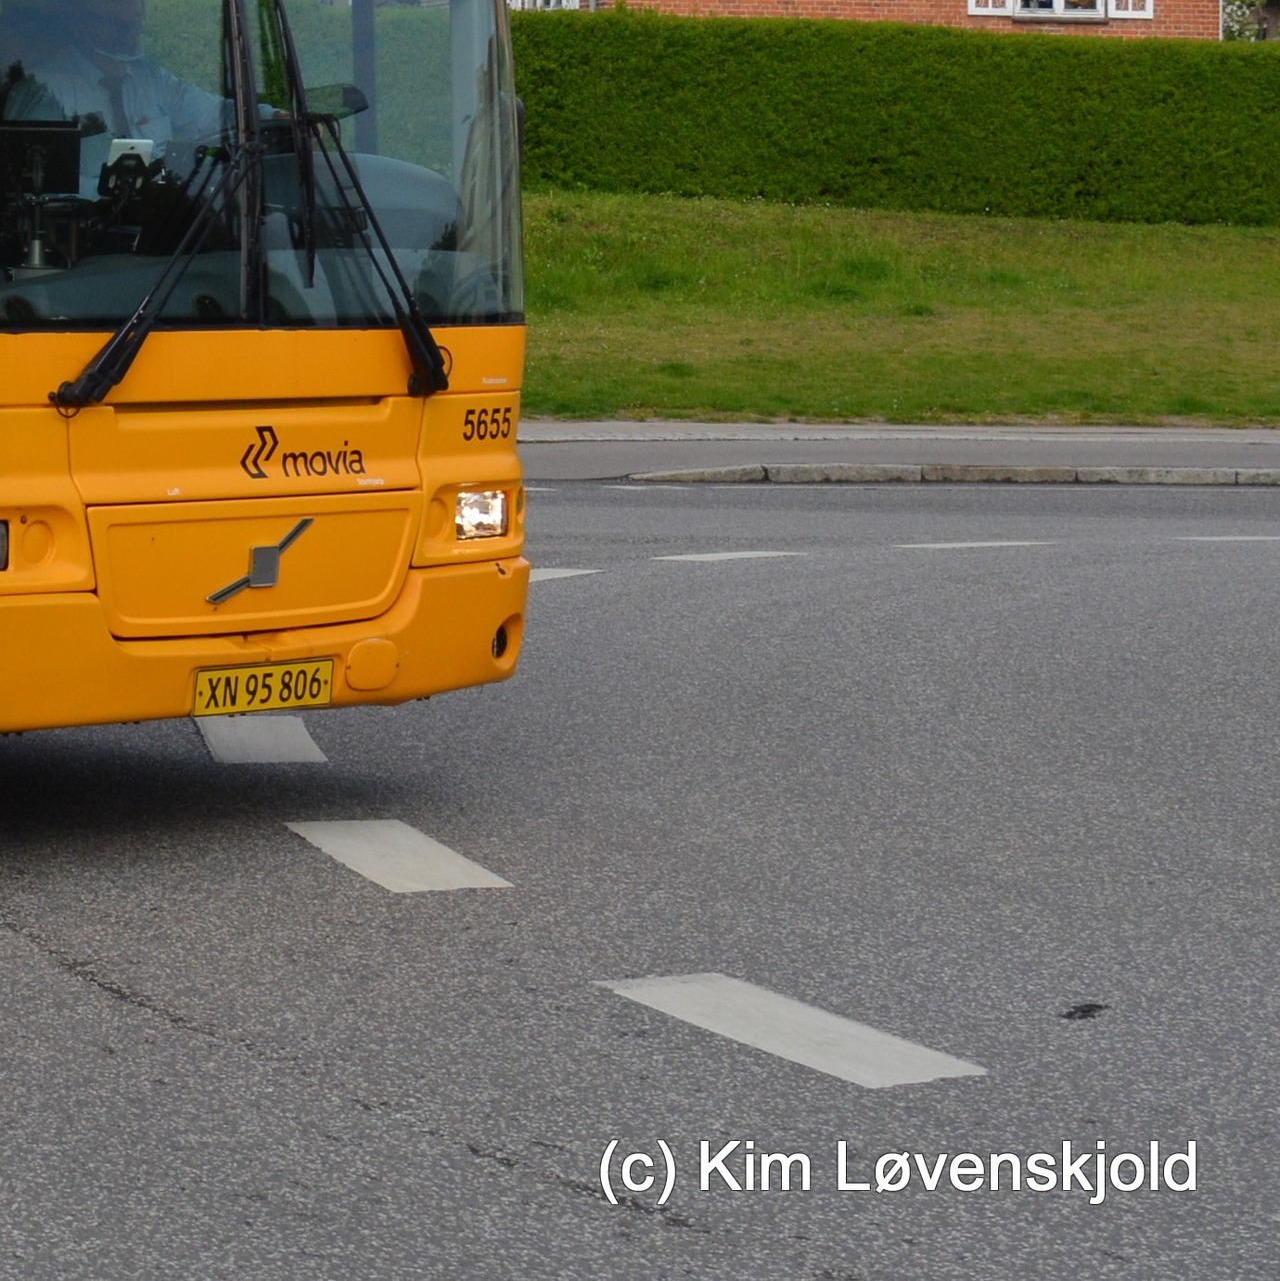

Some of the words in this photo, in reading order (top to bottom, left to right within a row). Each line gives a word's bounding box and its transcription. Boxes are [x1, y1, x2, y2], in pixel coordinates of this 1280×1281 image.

[462, 407, 512, 441] 5655
[281, 440, 366, 477] movia
[205, 676, 239, 709] XN
[245, 672, 273, 705] 95
[280, 667, 322, 702] 806
